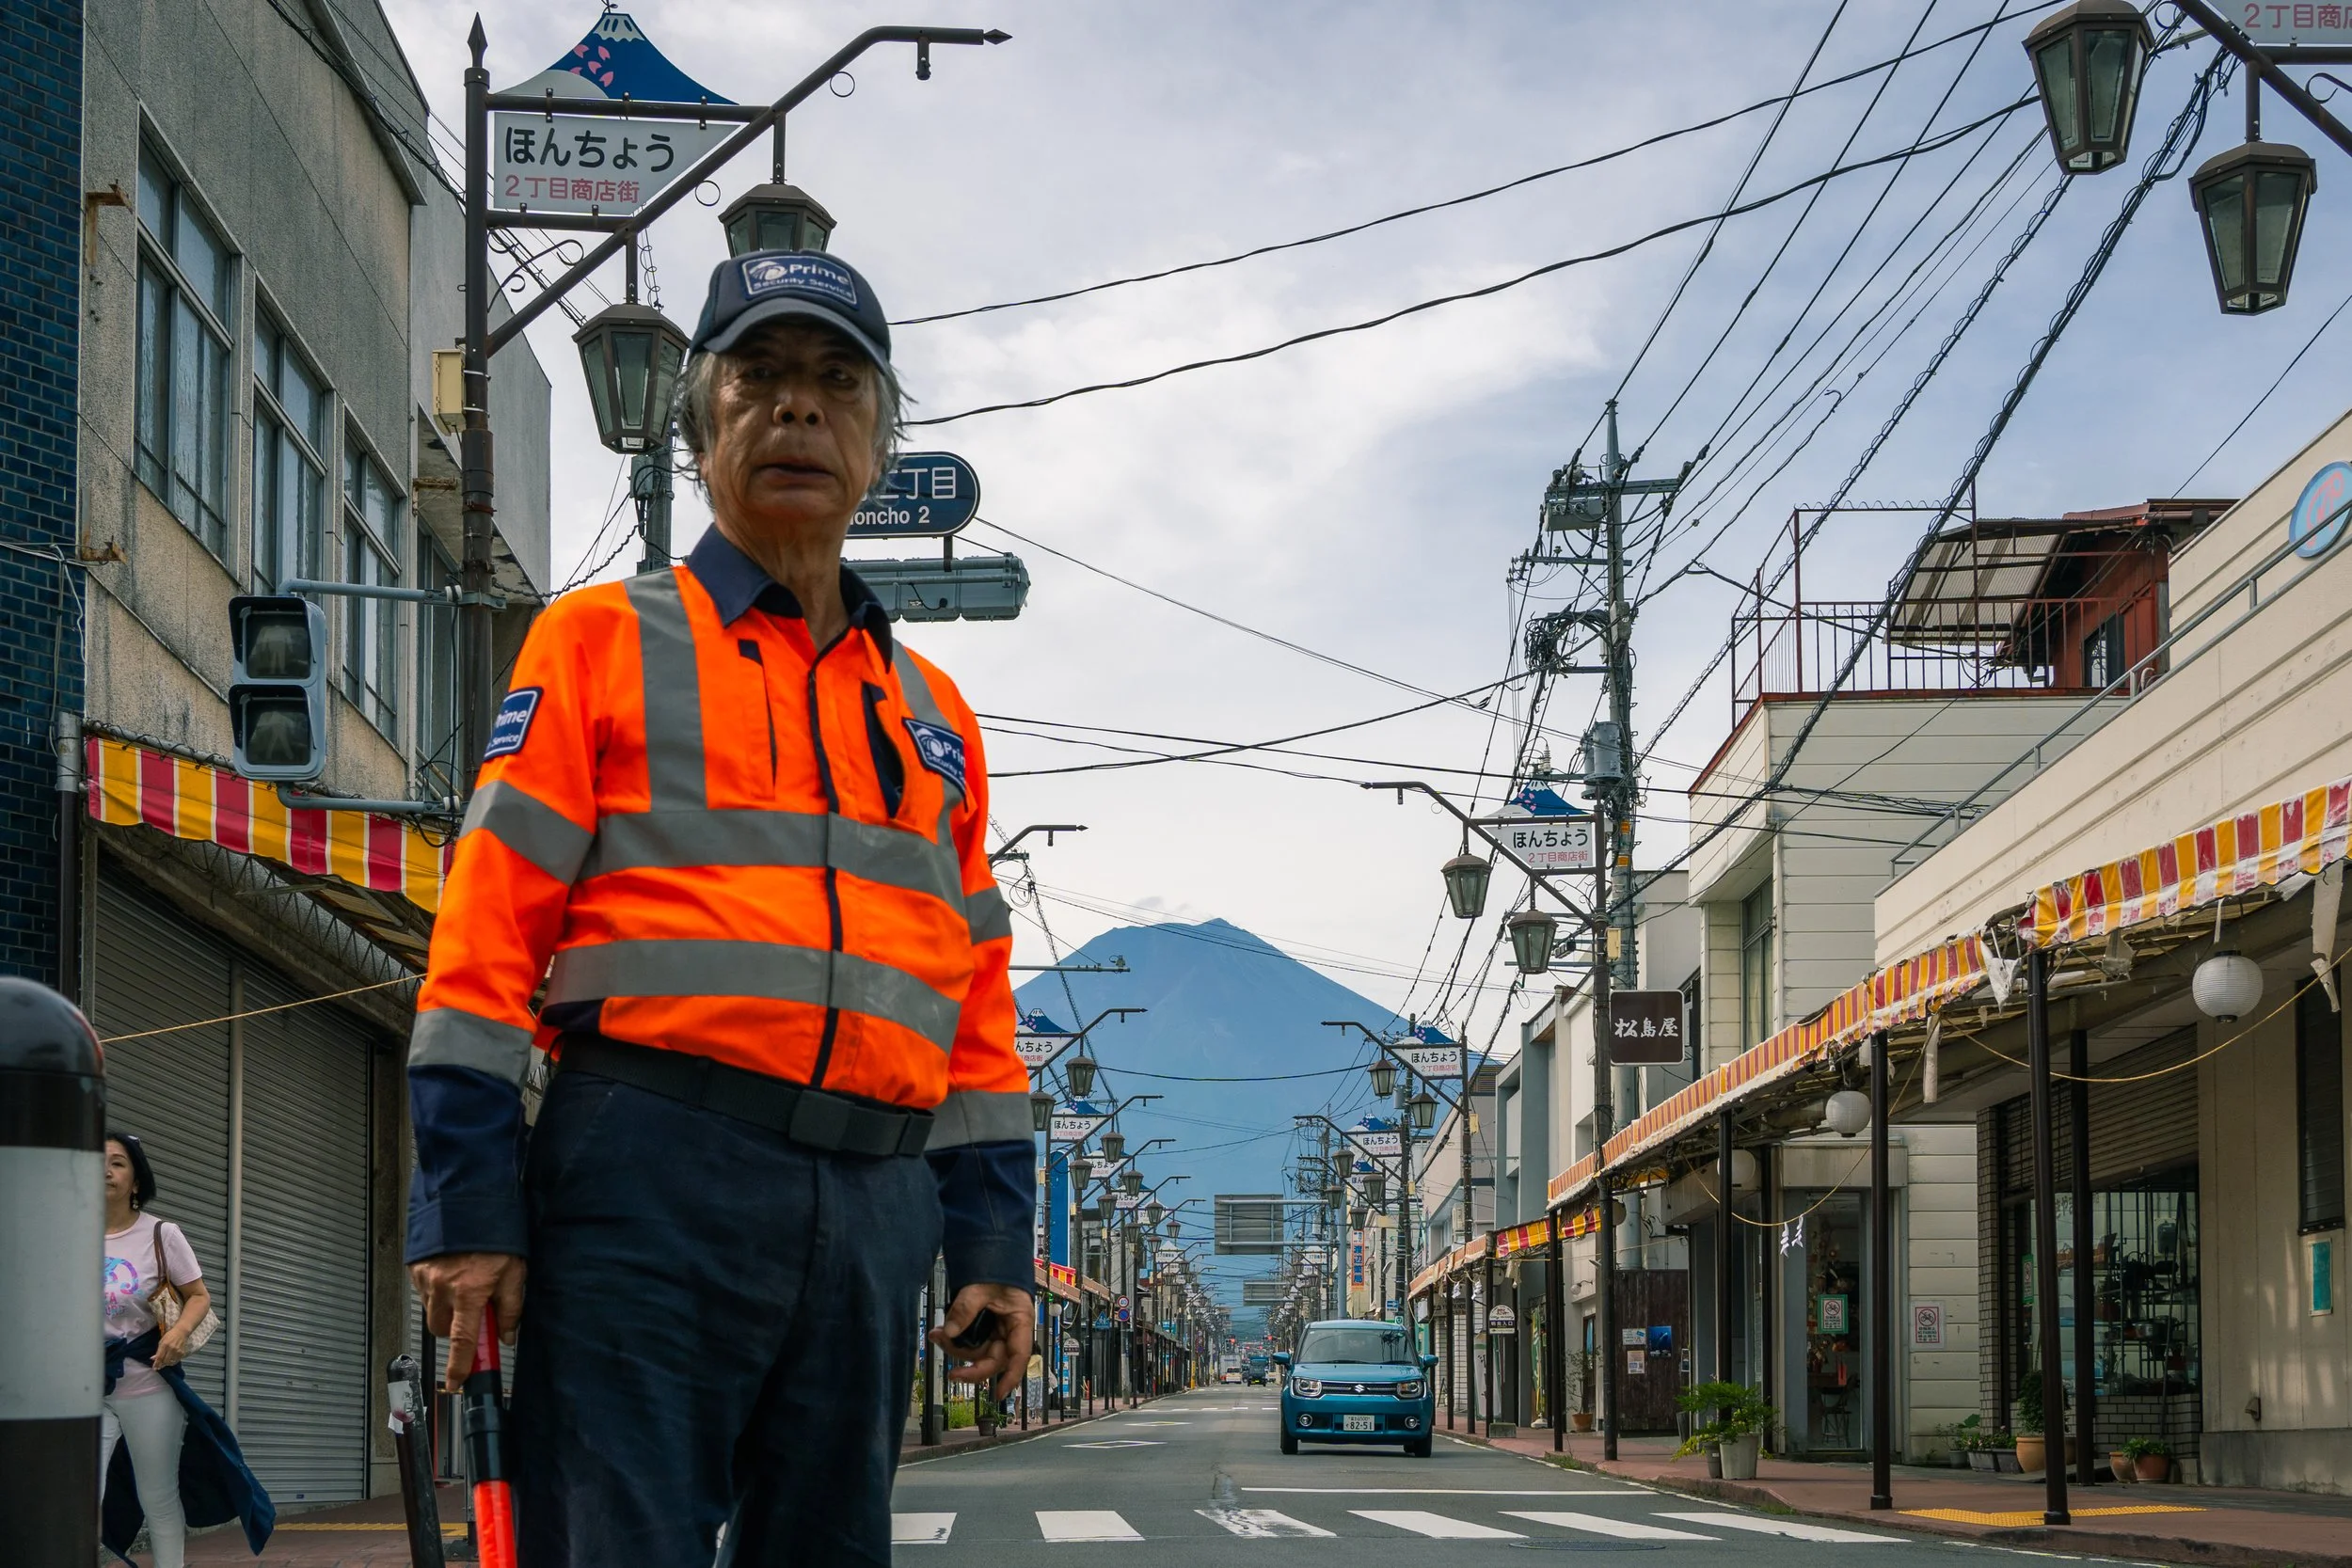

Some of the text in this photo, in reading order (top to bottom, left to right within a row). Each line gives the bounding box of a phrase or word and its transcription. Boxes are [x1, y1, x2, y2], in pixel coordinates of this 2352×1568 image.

[505, 126, 675, 173] ほんちょう
[505, 175, 641, 204] 2丁目商店街
[789, 264, 850, 285] Prime
[754, 277, 805, 291] Security
[860, 467, 957, 501] 二丁目
[918, 505, 930, 524] 2
[1513, 829, 1589, 848] ほんちょう
[1528, 850, 1588, 863] 2丁目商店街
[1614, 1017, 1679, 1038] 松島屋
[1015, 1040, 1054, 1053] んちょう
[1411, 1051, 1458, 1064] ほんちょう
[1054, 1120, 1091, 1130] ほんちょう
[1362, 1134, 1399, 1146] ほんちょう
[1350, 1421, 1372, 1430] 82-51
